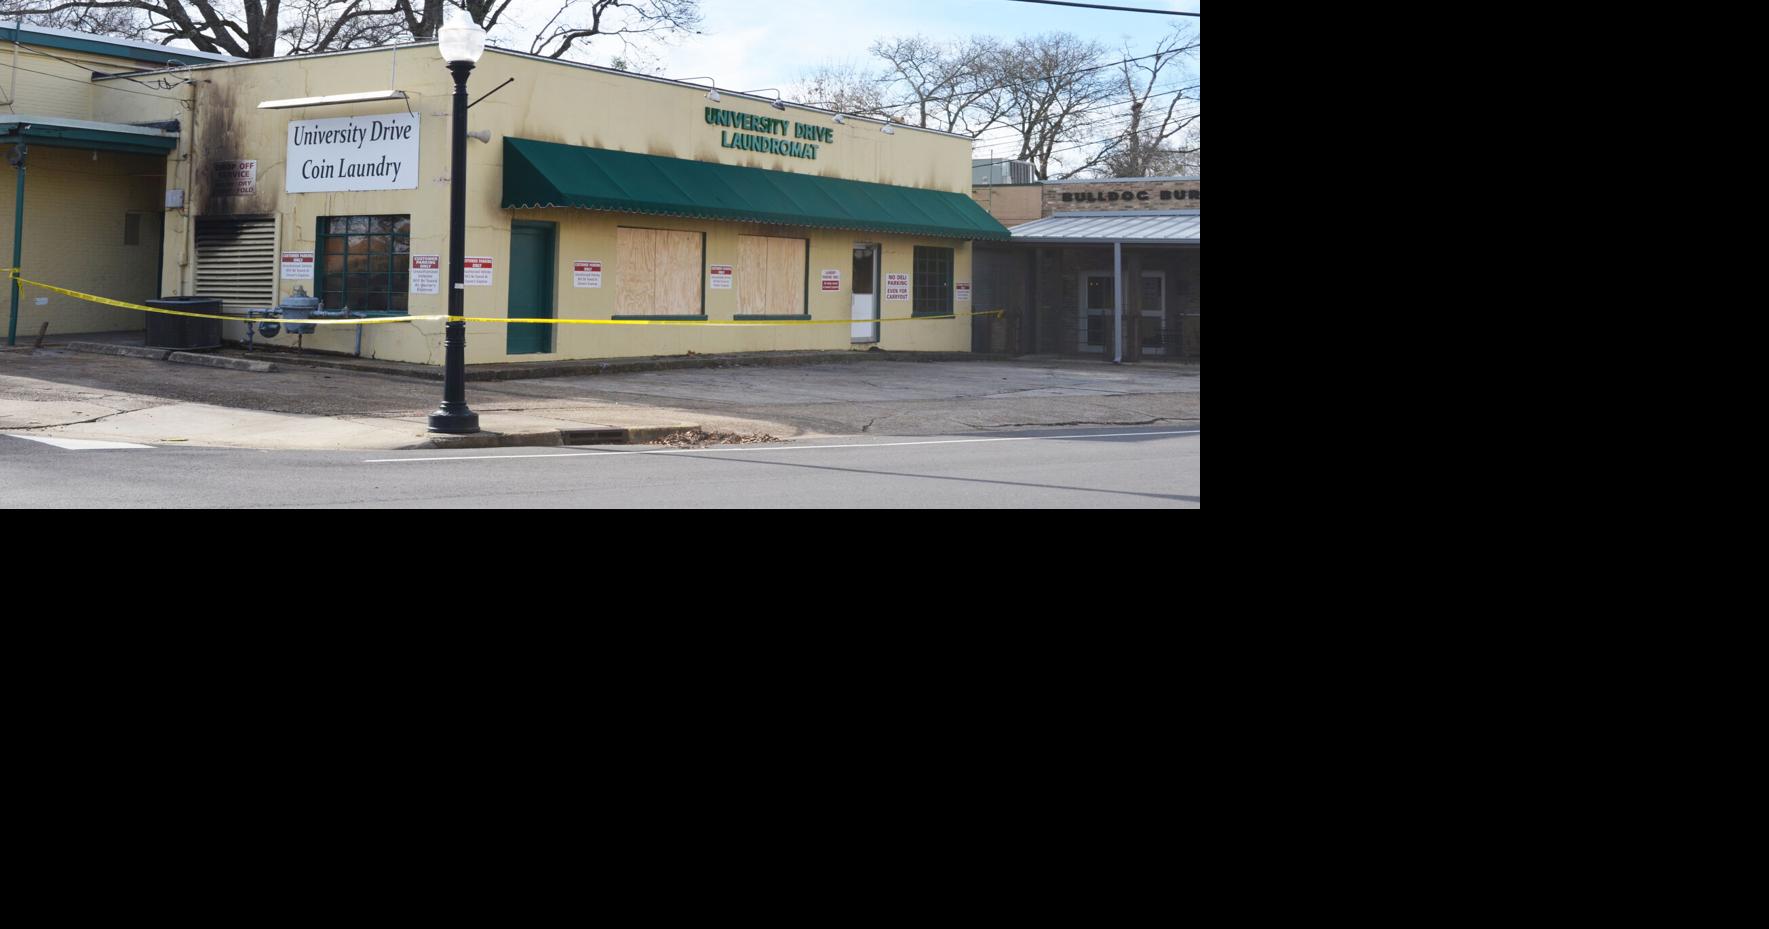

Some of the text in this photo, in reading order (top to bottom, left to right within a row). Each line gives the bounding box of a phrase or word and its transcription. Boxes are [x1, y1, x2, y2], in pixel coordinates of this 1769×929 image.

[294, 120, 412, 148] University Drive
[705, 107, 833, 144] UNIVERSITY DRIVE
[721, 130, 819, 160] LAUNDROMAT
[302, 155, 401, 182] Coin Laundry
[1062, 190, 1200, 202] BULLDOG BUR
